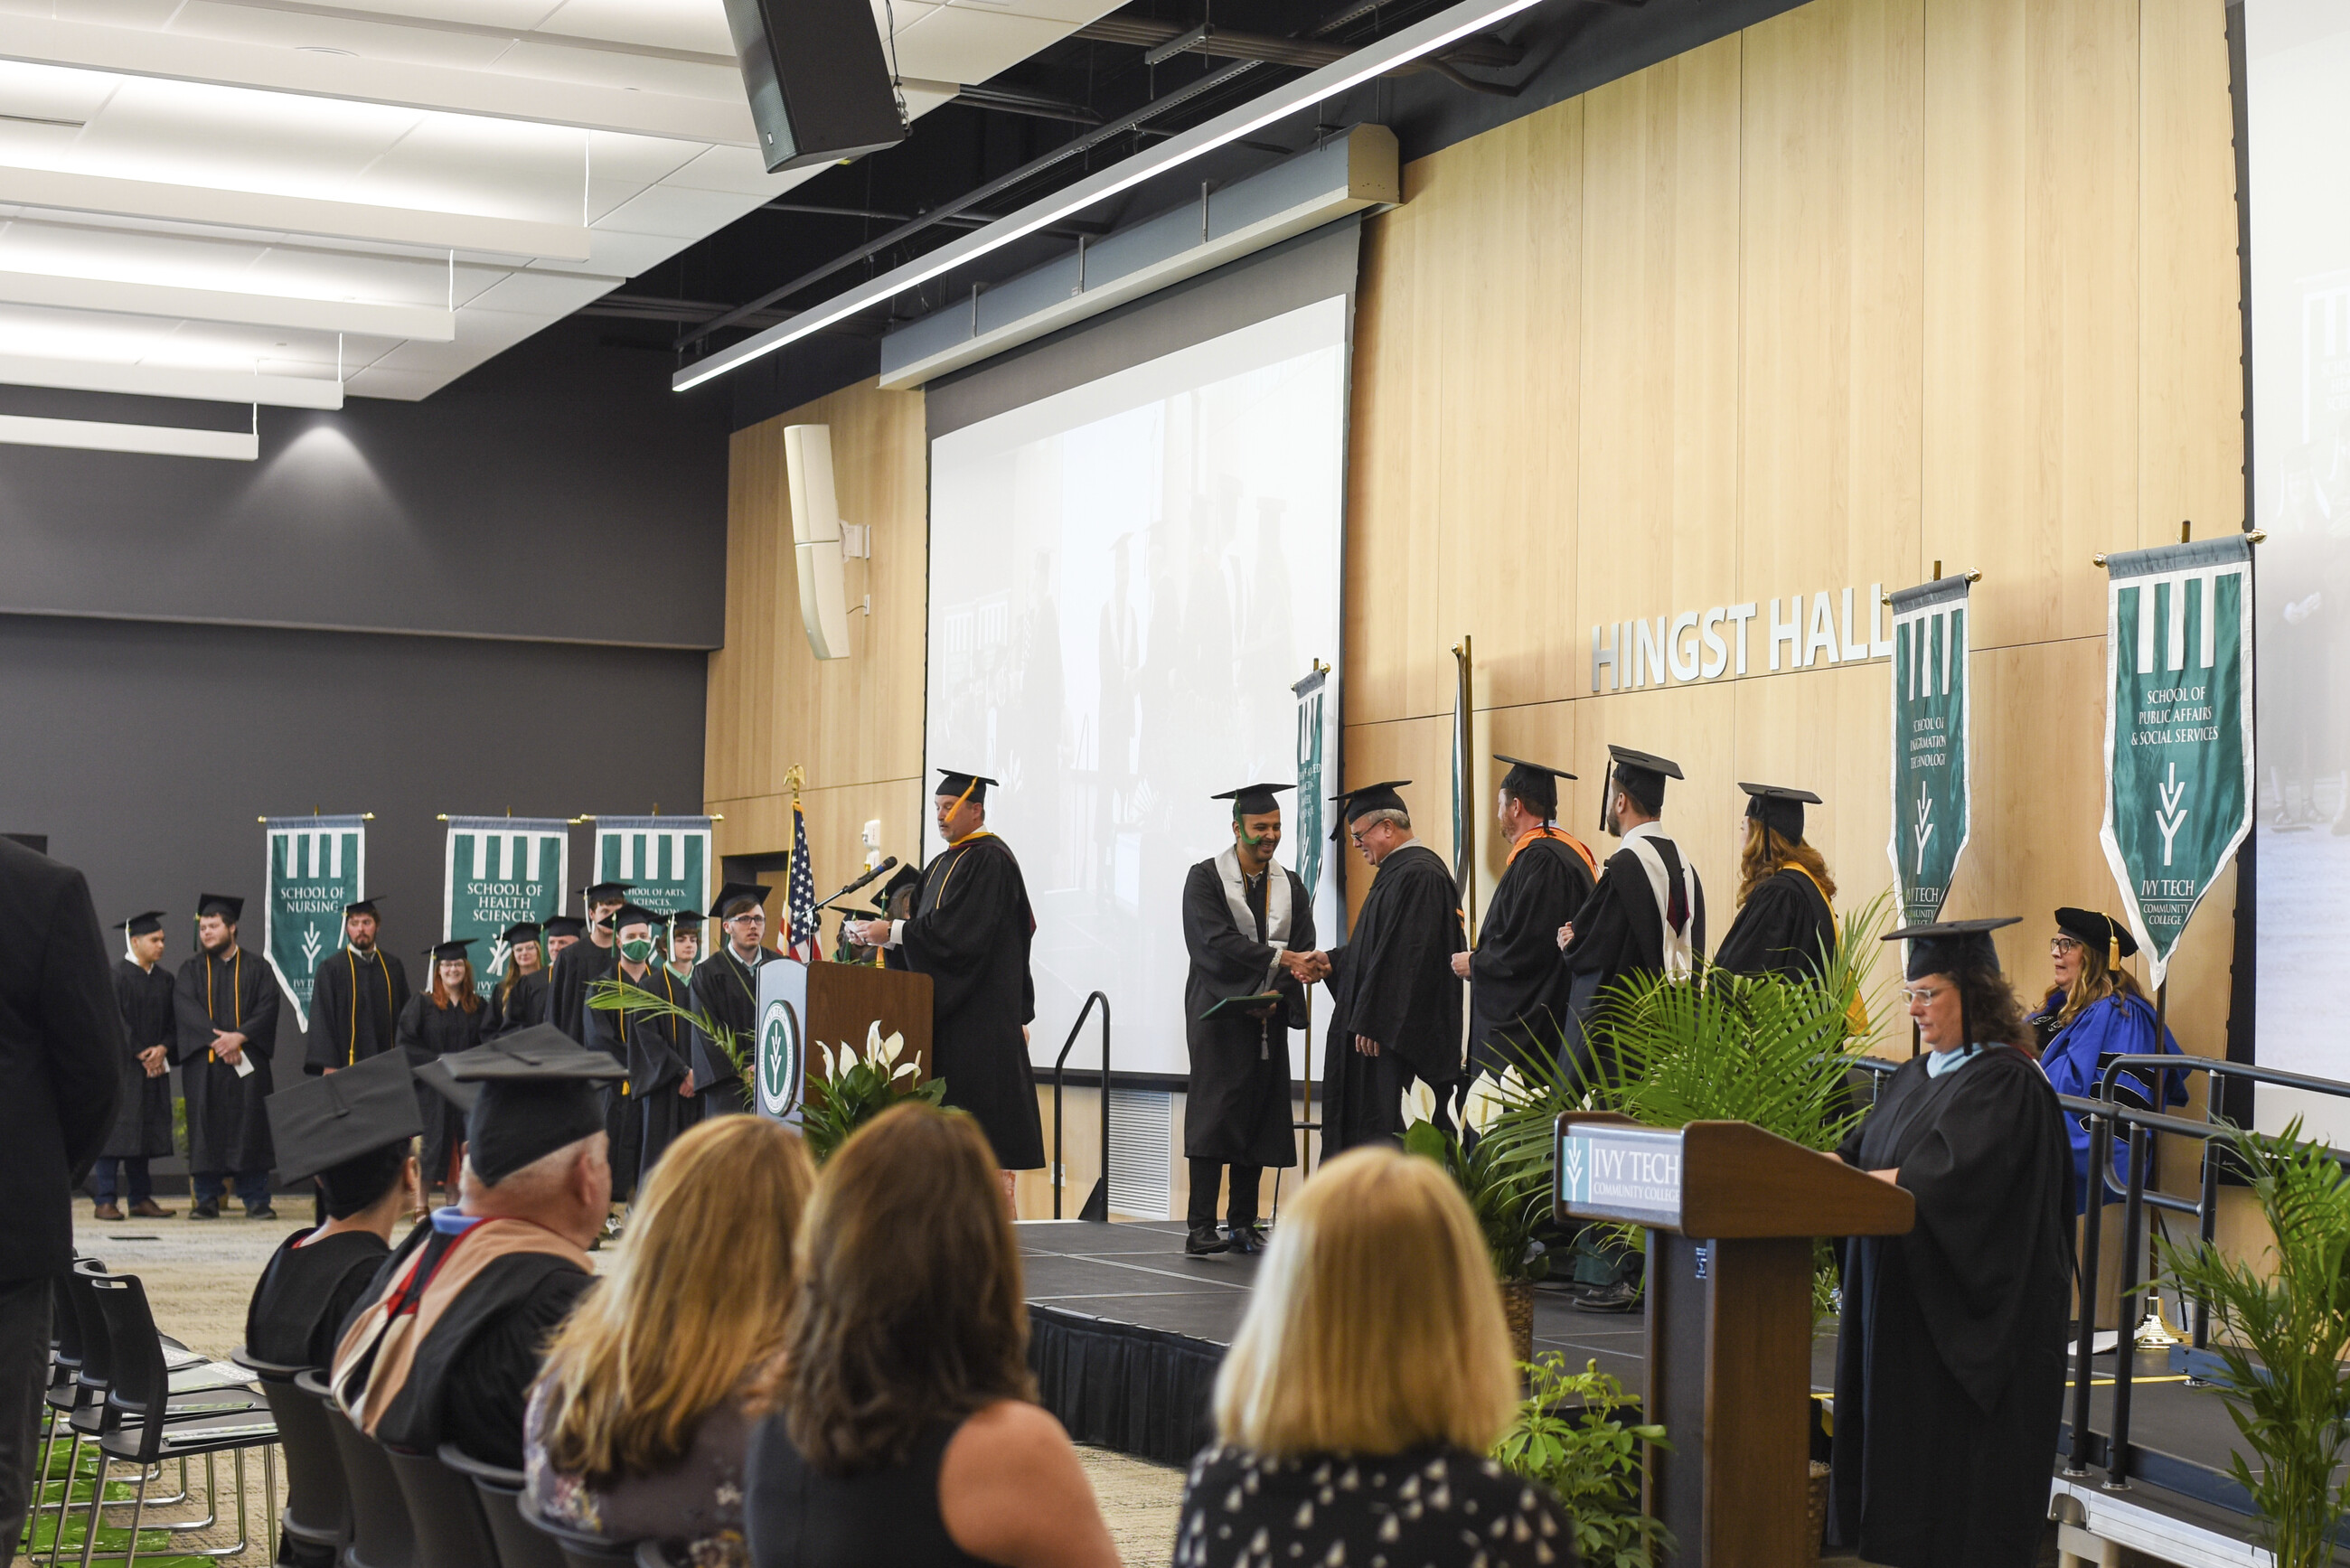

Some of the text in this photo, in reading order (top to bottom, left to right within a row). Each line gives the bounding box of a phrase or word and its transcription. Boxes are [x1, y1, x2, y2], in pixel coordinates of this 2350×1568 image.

[1591, 582, 1892, 692] HINGST HALL
[2147, 686, 2206, 705] SCHOOL OF
[2138, 705, 2212, 726] PUBLIC AFFAIRS
[1913, 717, 1934, 733] CHOOL
[2130, 725, 2219, 746] & SOCIAL SERVICES
[280, 887, 345, 899] SCHOOL OF
[466, 882, 543, 897] SCHOOL OF
[623, 887, 651, 897] HOOL
[652, 887, 663, 897] OF
[1914, 887, 1939, 903] TECH
[2141, 879, 2195, 897] IVY TECH
[286, 901, 338, 914] NURSING
[478, 896, 531, 909] HEALTH
[2143, 903, 2190, 914] COMMUNITY
[473, 909, 536, 923] SCIENCES
[2148, 915, 2183, 925] COLLEGE
[477, 981, 494, 991] IVY
[1594, 1148, 1680, 1185] IVY TECH
[1593, 1182, 1679, 1202] COMMUNITY COLLEGE
